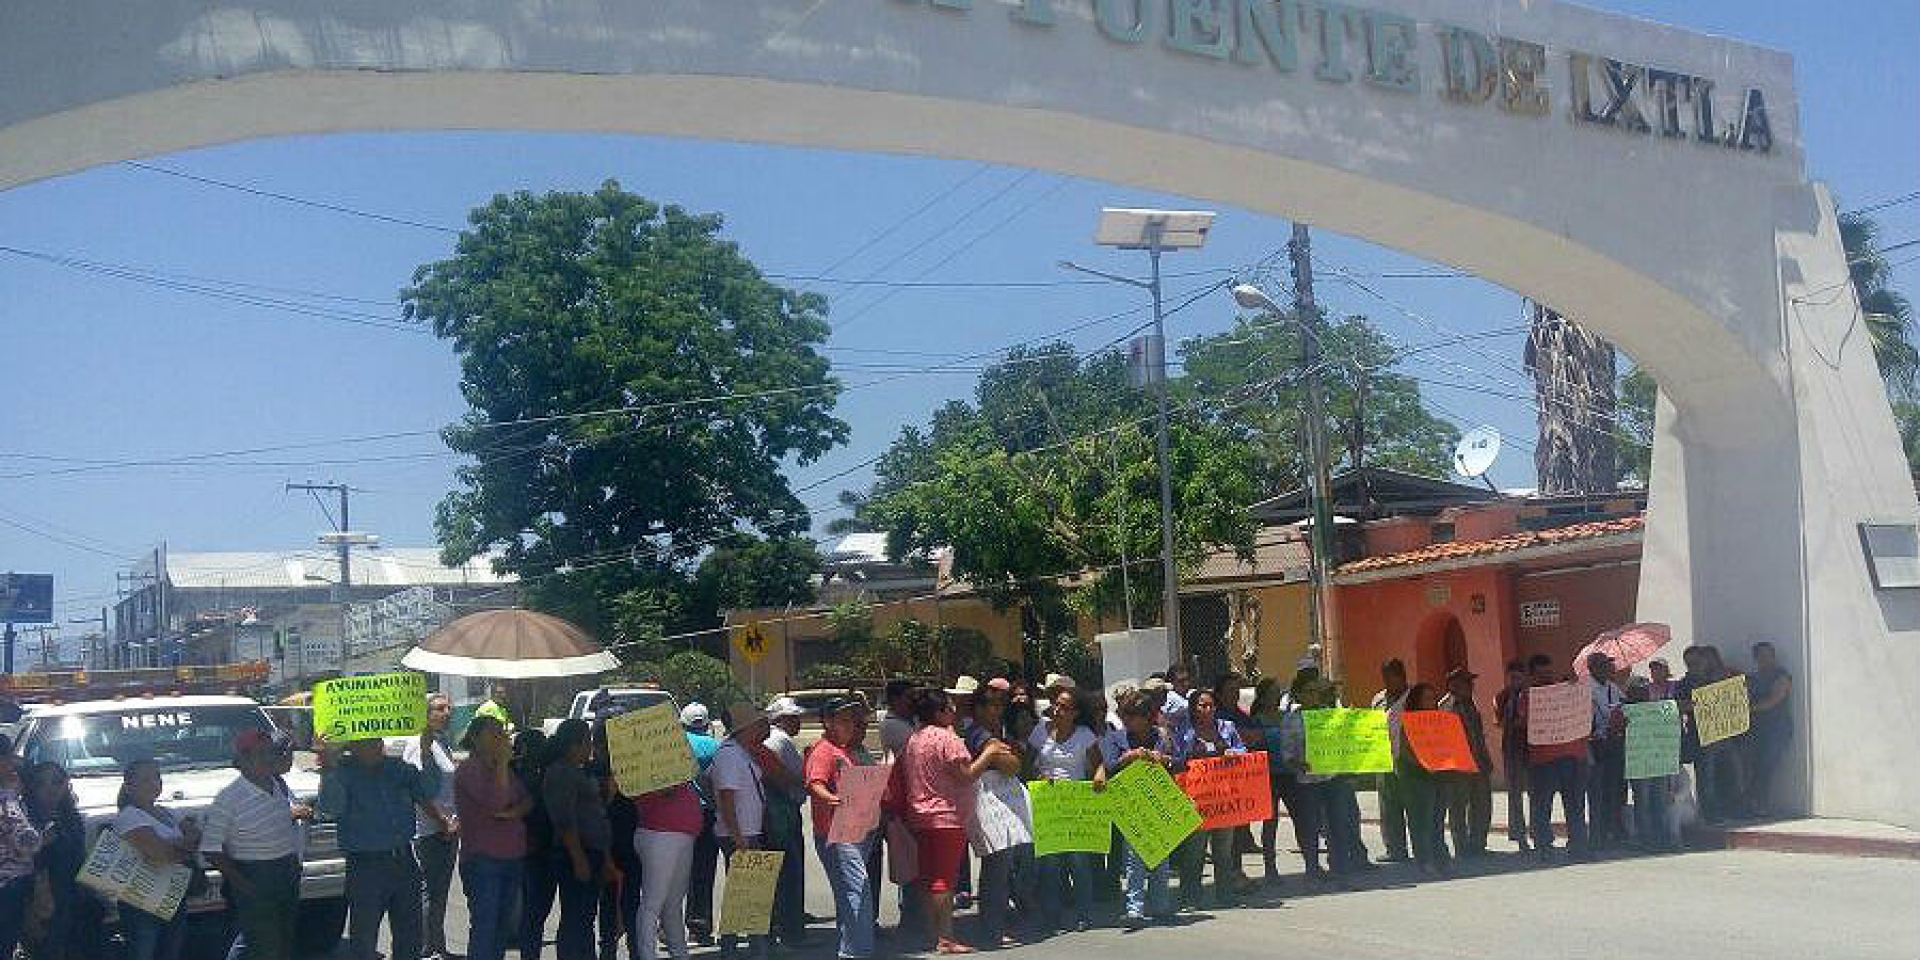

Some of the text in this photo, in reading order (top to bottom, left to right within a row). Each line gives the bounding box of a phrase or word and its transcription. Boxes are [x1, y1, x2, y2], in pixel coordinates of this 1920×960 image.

[1438, 25, 1551, 116] DE
[1568, 52, 1774, 151] IXTLA
[121, 712, 192, 729] NENE
